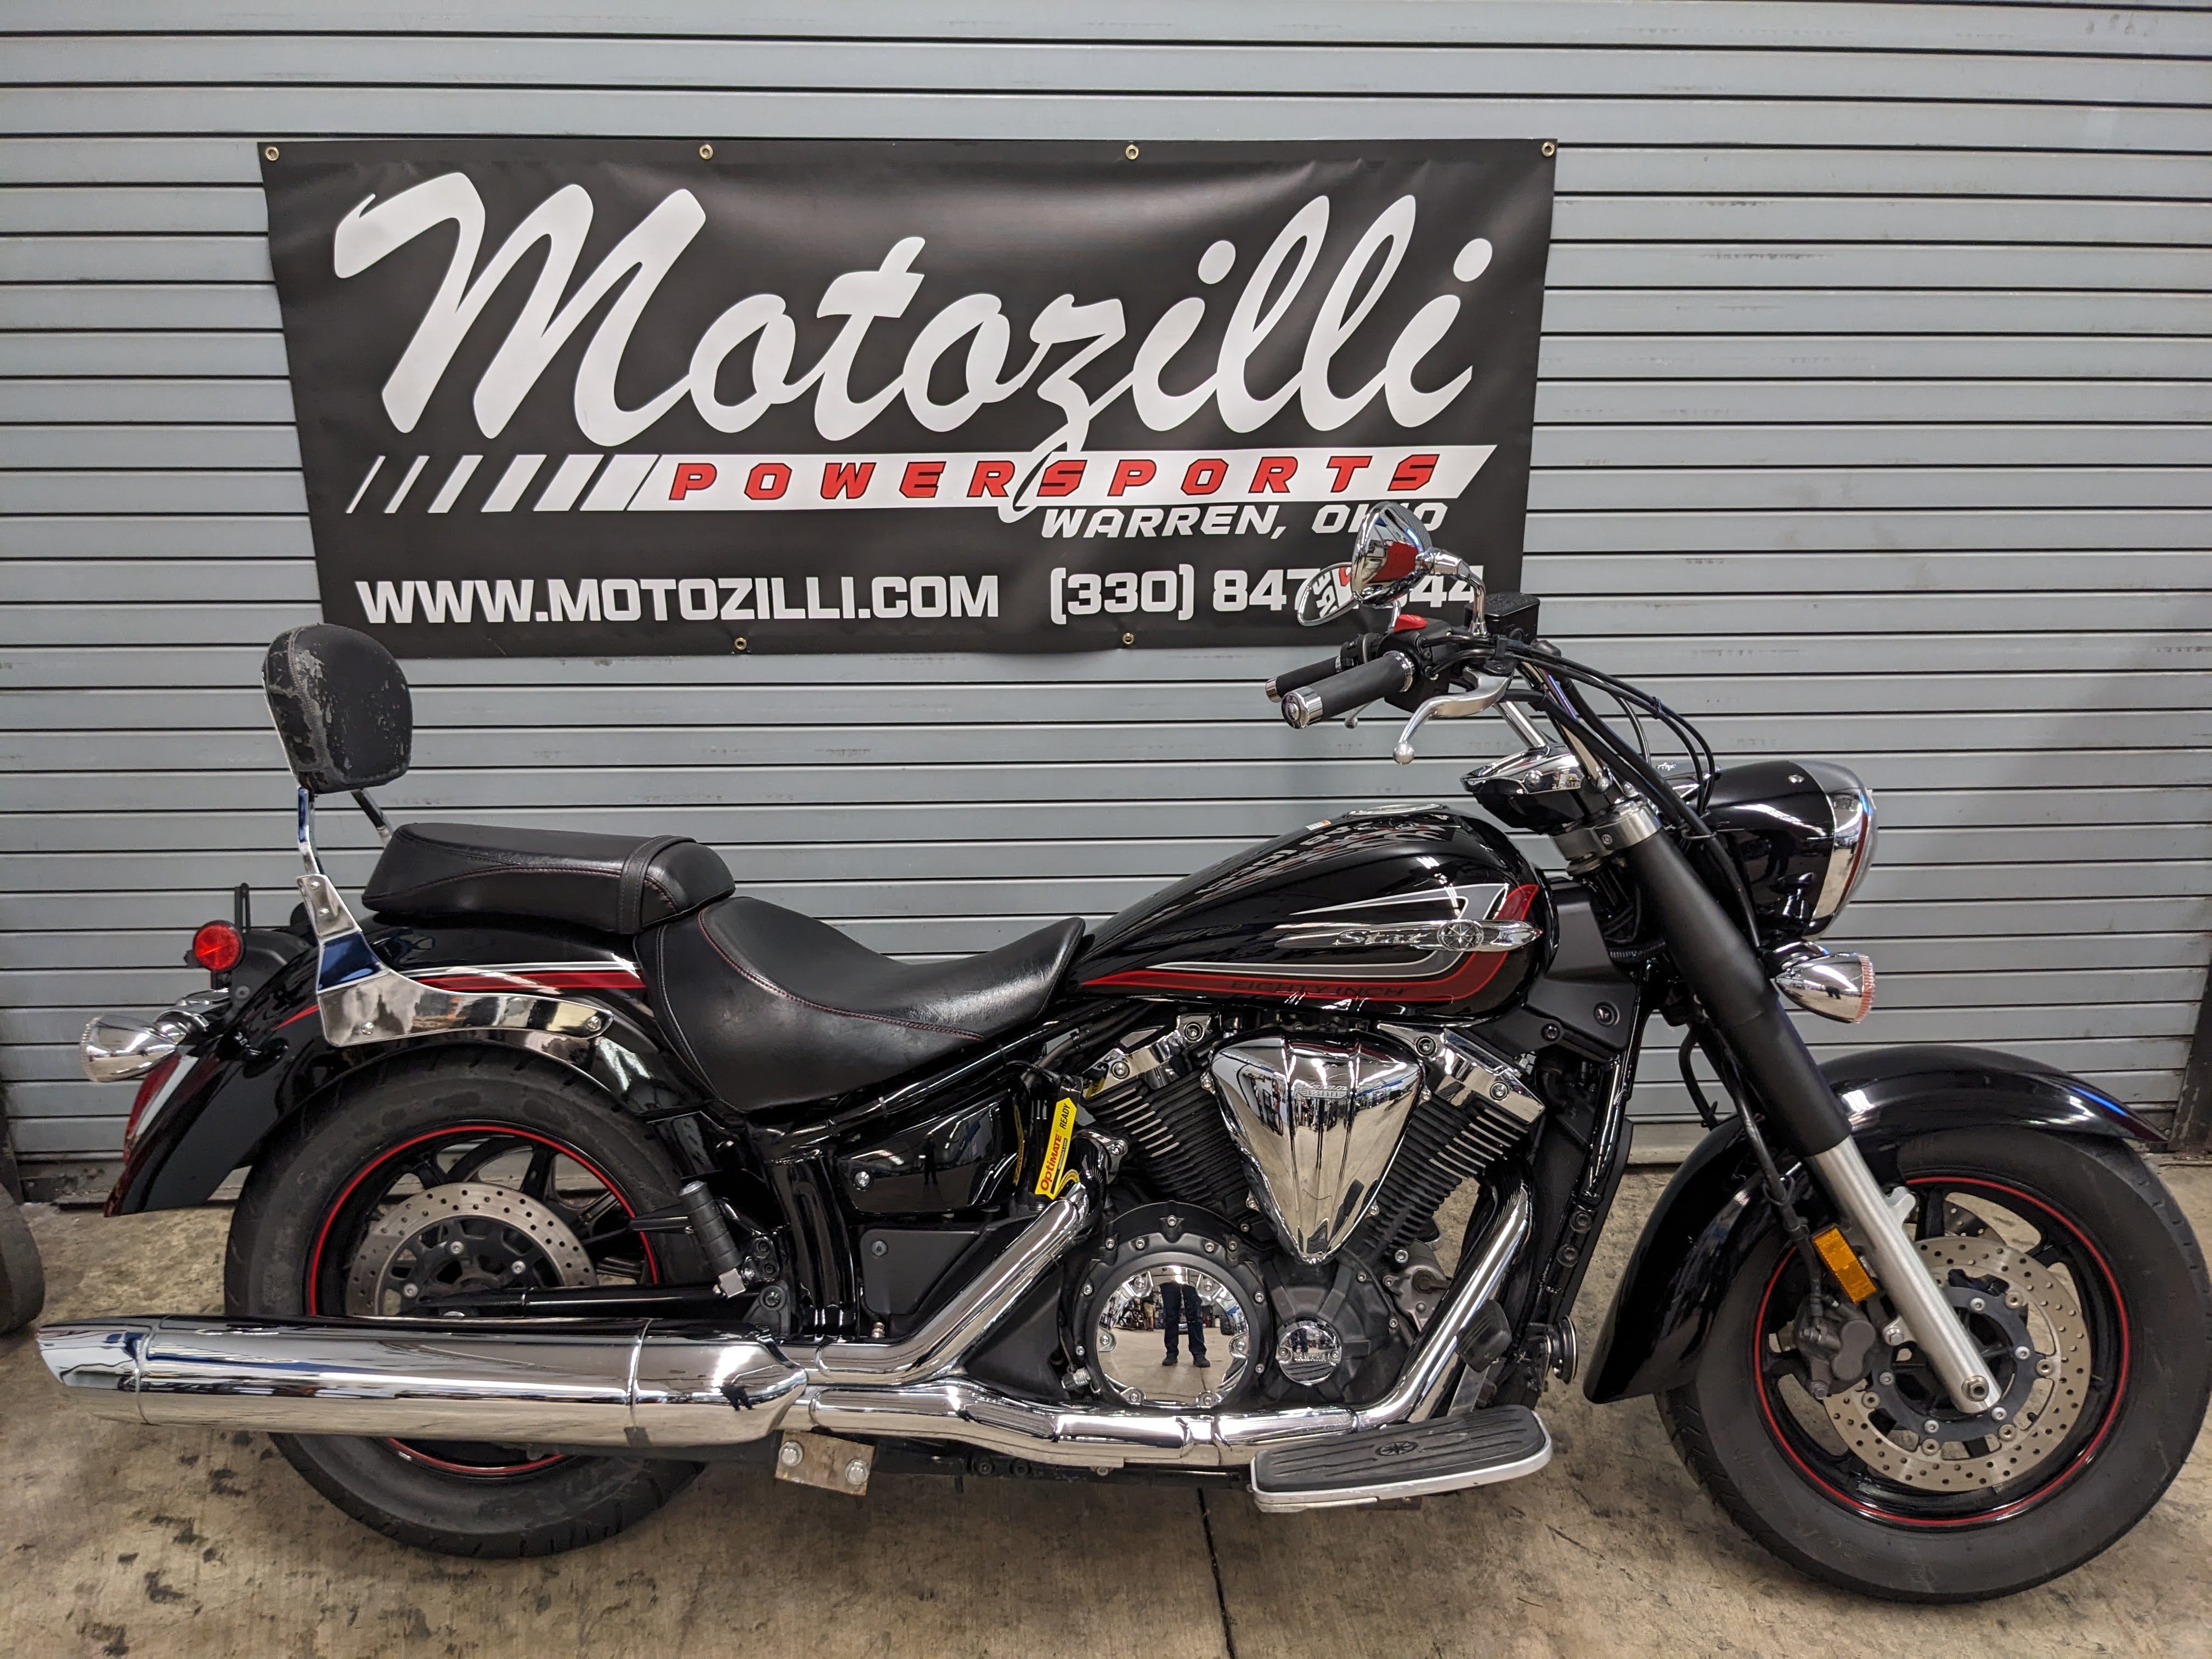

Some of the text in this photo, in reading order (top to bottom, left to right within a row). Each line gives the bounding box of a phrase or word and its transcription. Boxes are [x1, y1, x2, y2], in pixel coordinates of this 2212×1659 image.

[334, 172, 1493, 523] Motozilli
[669, 454, 1439, 500] POWERSPORTS
[1041, 502, 1448, 539] WARREN, OO
[354, 575, 999, 624] WWW.MOTOZILLI.COM
[1050, 565, 1194, 625] (330)
[1040, 1102, 1071, 1192] OptiMATE READY
